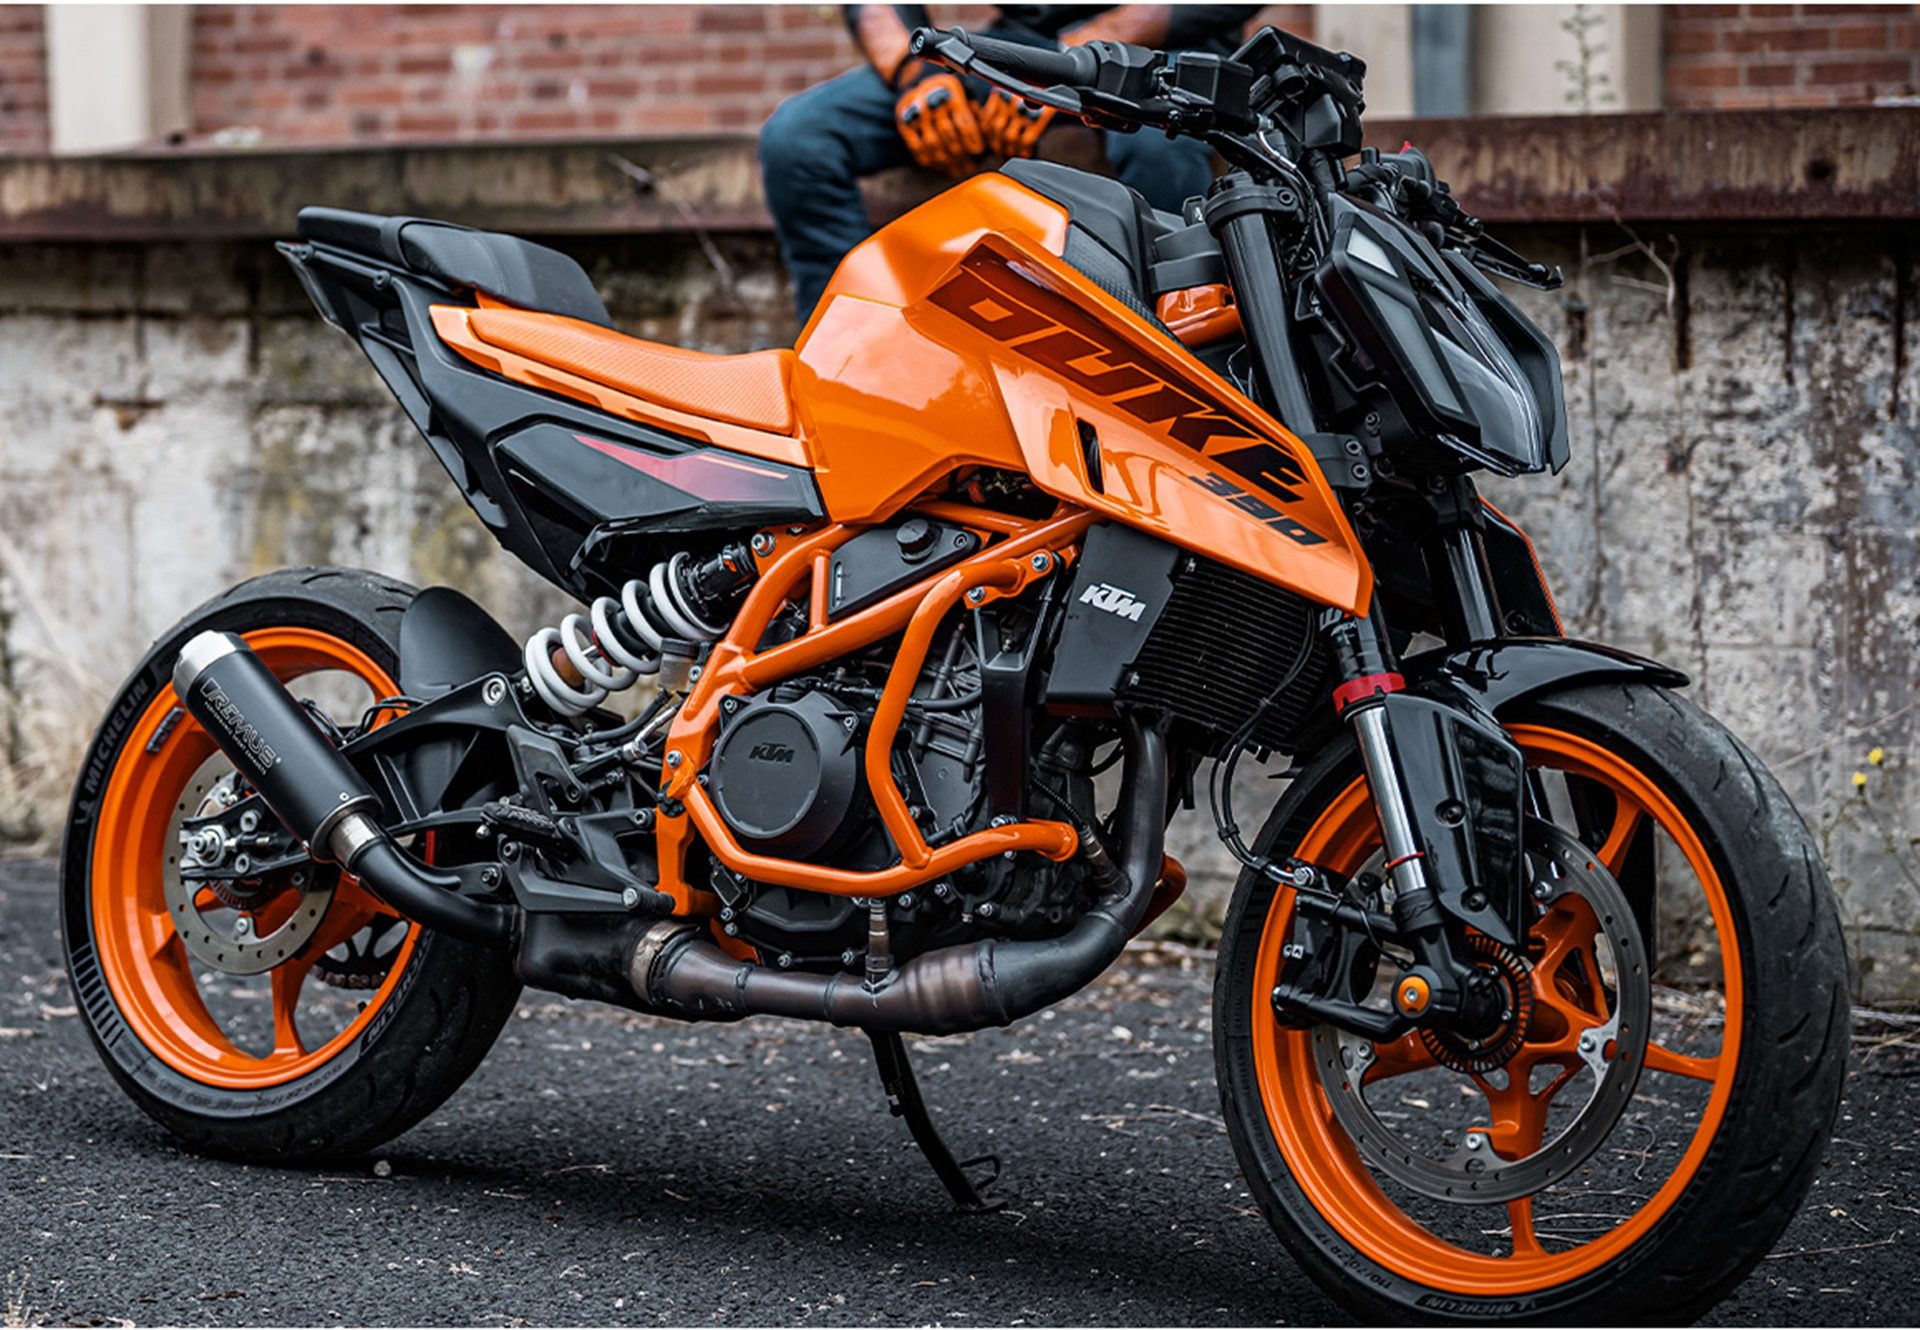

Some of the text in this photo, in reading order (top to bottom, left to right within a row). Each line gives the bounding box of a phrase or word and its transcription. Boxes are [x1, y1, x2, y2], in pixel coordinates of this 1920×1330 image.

[926, 267, 1311, 504] DUKE
[1188, 471, 1329, 547] 390
[1079, 582, 1147, 622] KTM
[84, 677, 149, 794] MICHELIN
[201, 677, 277, 768] REMUS
[748, 742, 795, 763] KTM
[1424, 1299, 1515, 1314] MICHELIN
